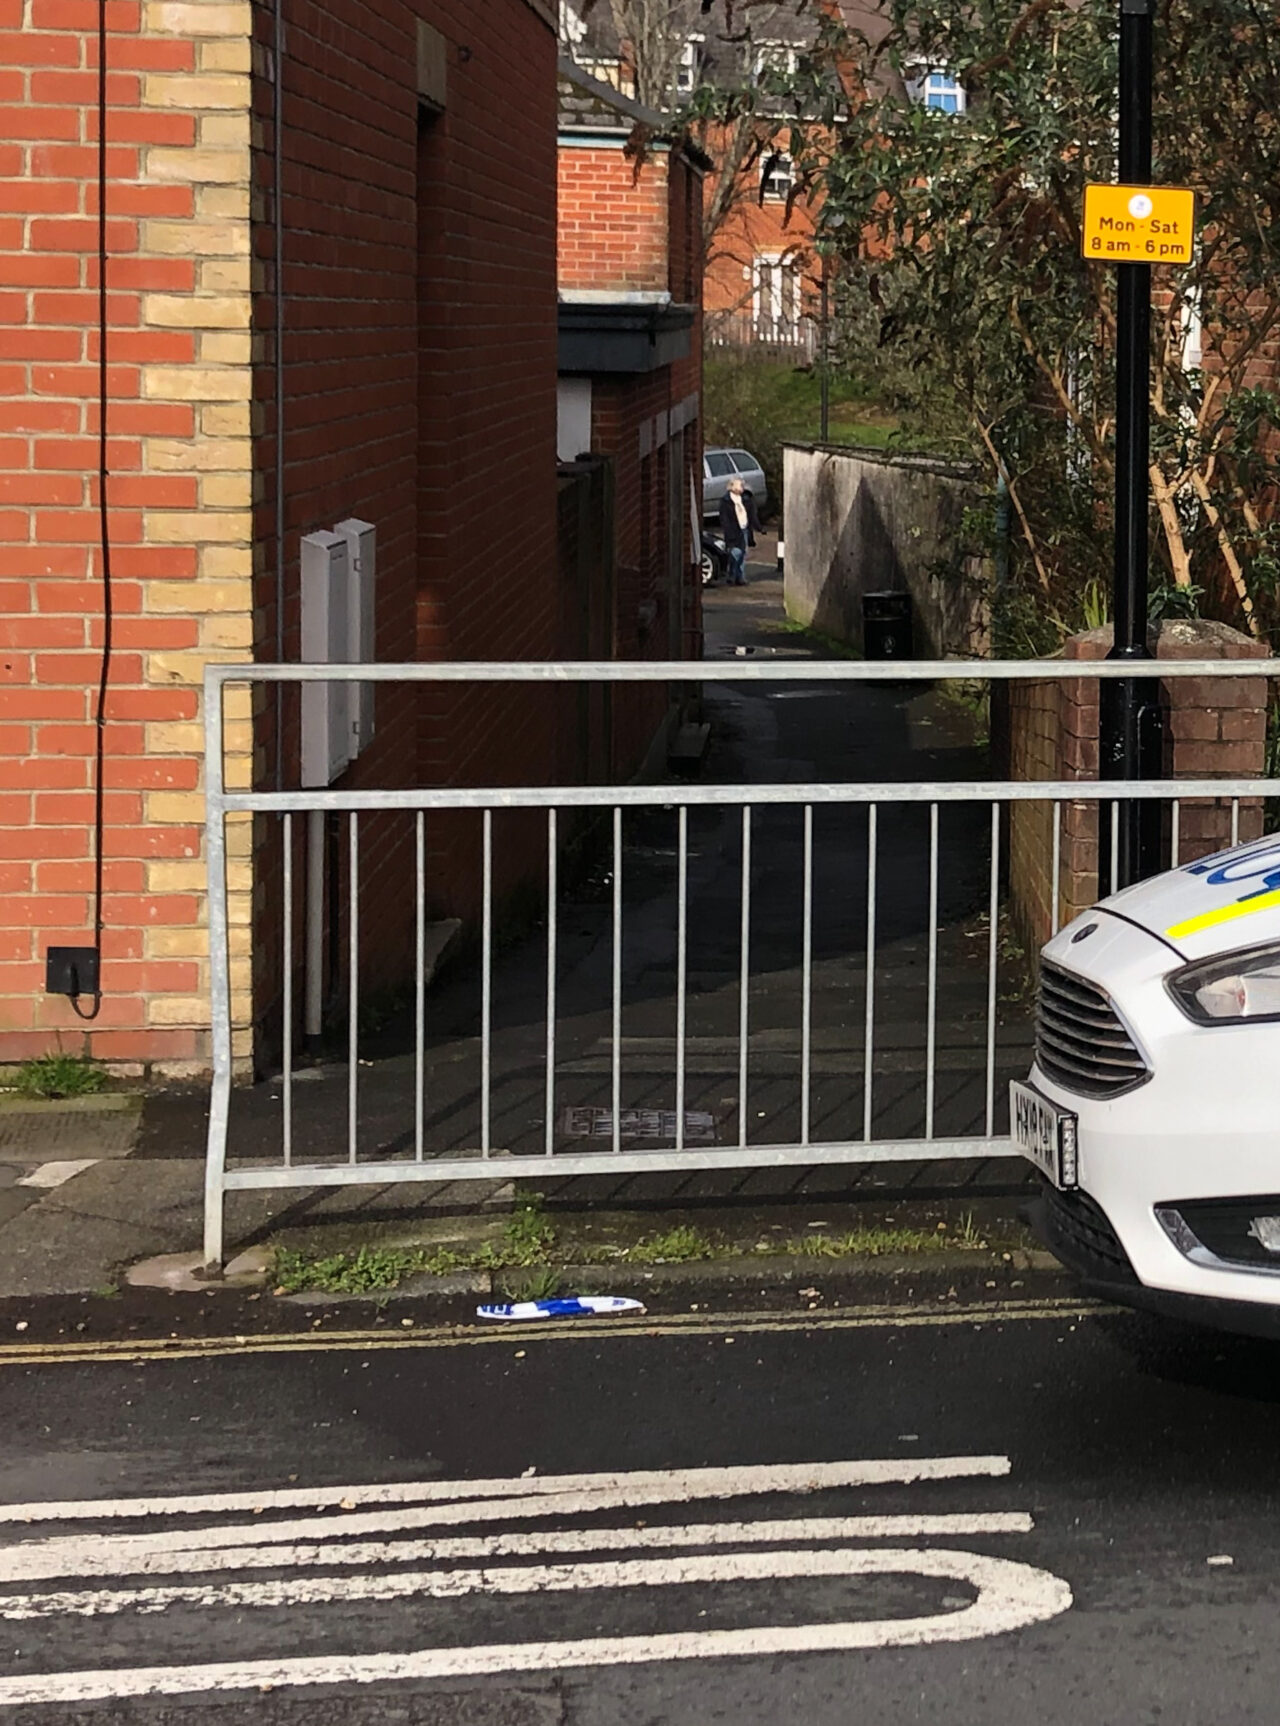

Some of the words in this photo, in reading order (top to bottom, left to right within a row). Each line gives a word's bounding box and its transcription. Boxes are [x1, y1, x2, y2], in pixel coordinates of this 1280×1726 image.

[1099, 216, 1135, 232] Mon
[1149, 219, 1179, 234] Sat
[1091, 236, 1102, 251] 8
[1106, 240, 1130, 252] am
[1145, 240, 1156, 254] 6
[1160, 243, 1185, 256] pm
